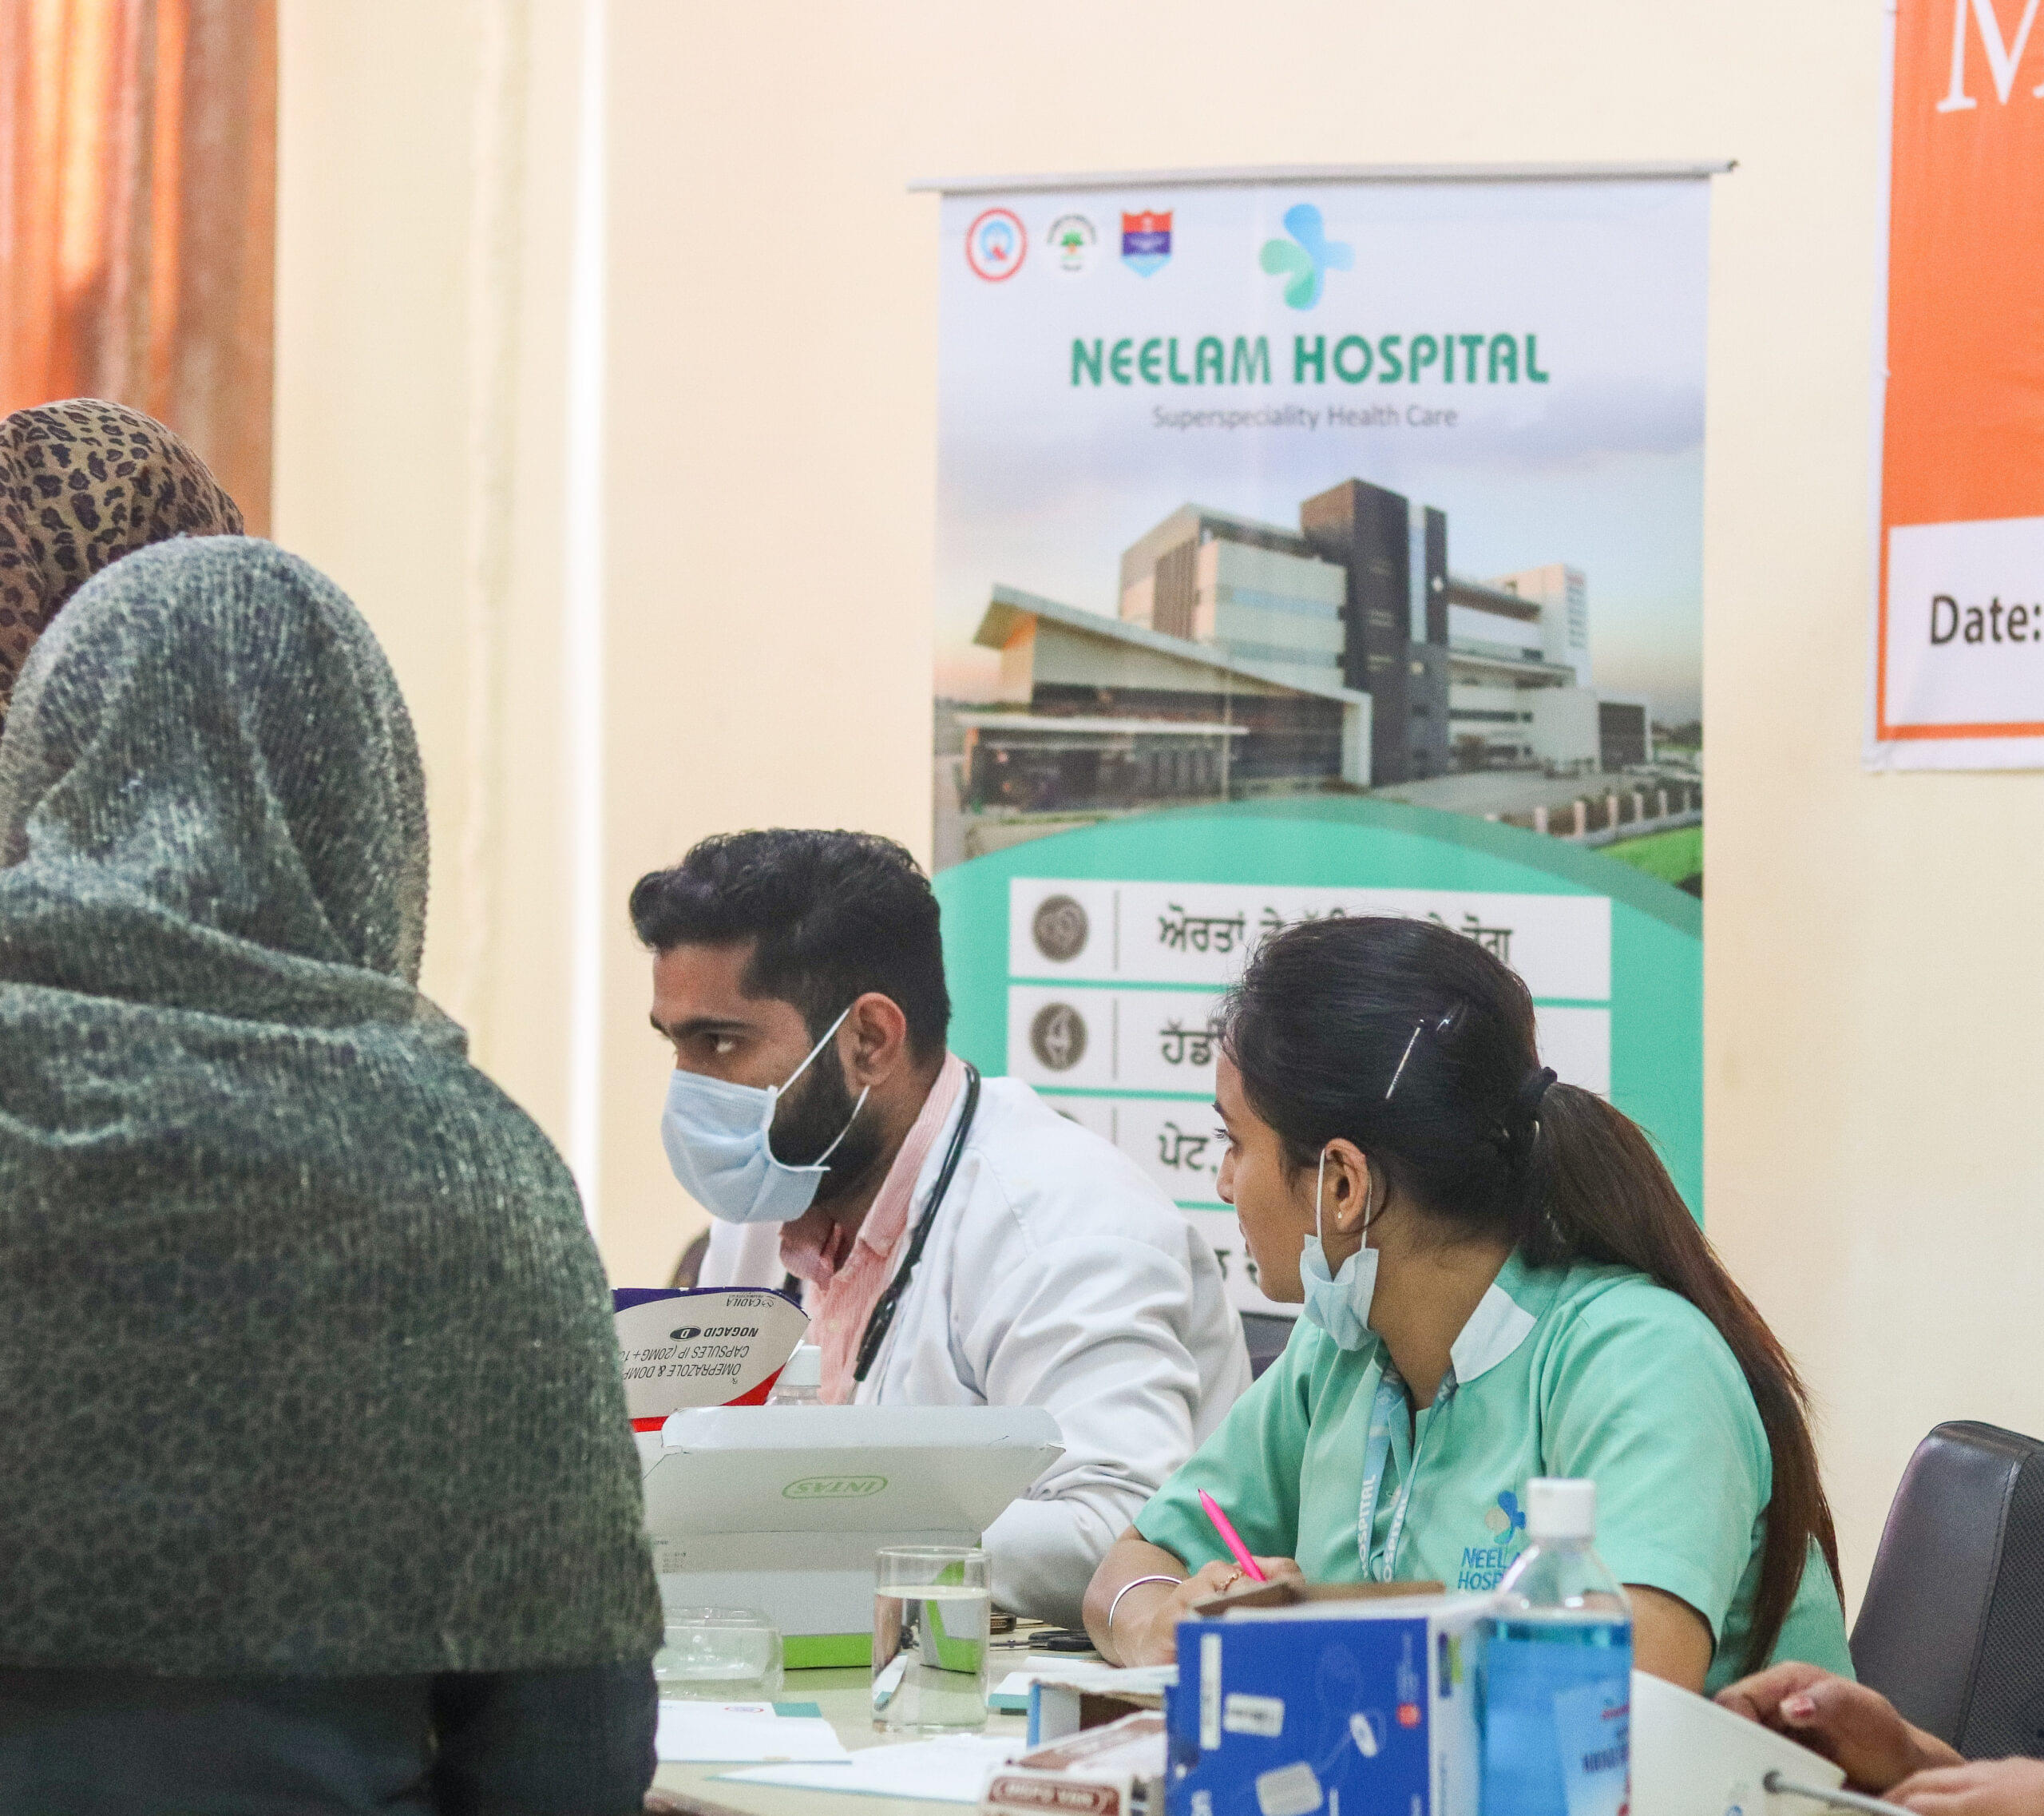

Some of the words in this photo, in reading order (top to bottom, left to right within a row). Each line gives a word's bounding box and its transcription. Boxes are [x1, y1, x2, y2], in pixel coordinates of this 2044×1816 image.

[1071, 335, 1271, 387] NEELAM
[1293, 332, 1550, 385] HOSPITAL
[1152, 405, 1318, 433] Superspeciality
[1327, 405, 1400, 428] Health
[1408, 405, 1459, 428] Care
[1930, 595, 2041, 645] Date:
[726, 1298, 761, 1307] CADILA
[703, 1326, 759, 1338] NOGACID
[679, 1346, 690, 1359] IP
[691, 1346, 750, 1358] CAPSULES
[657, 1365, 666, 1377] &
[667, 1363, 742, 1377] OMEPRAZOLE
